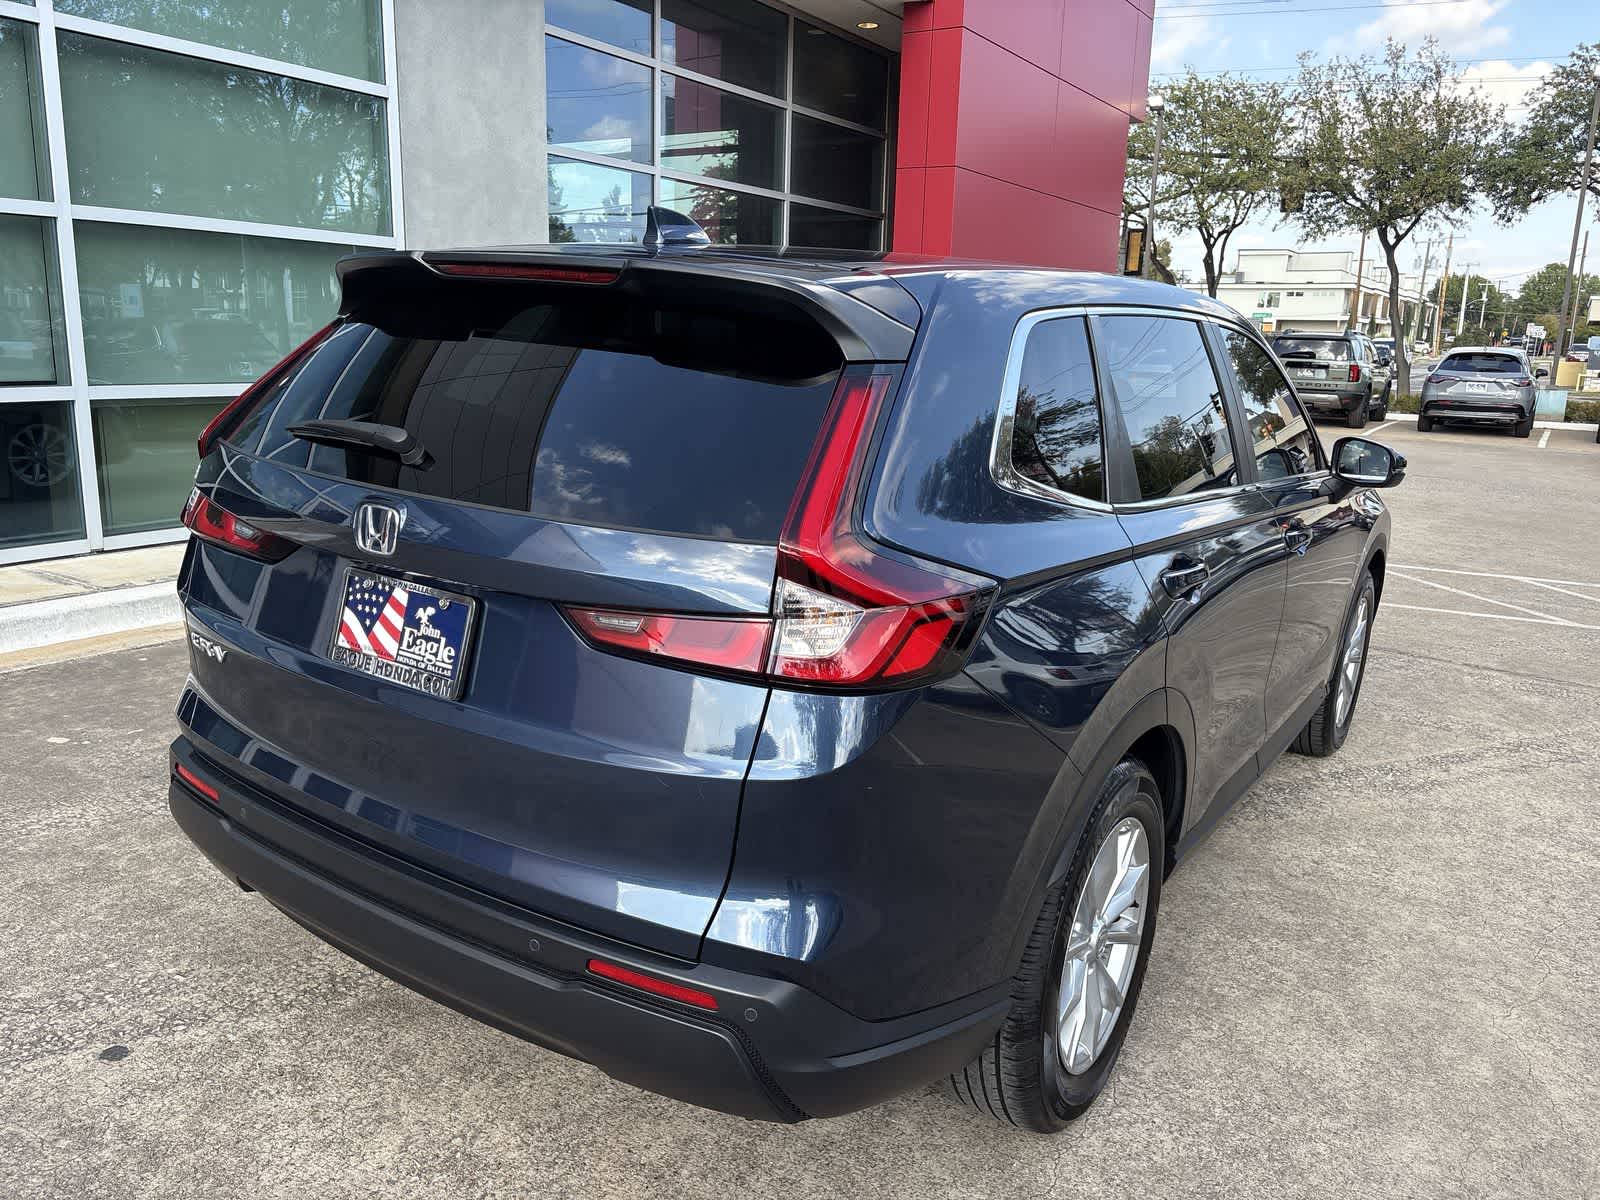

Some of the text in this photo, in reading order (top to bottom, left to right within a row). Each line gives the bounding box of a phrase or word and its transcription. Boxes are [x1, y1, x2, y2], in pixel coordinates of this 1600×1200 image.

[1296, 381, 1342, 389] SPORT
[417, 624, 441, 639] John
[191, 632, 229, 664] CR-V
[400, 626, 456, 665] Eagle
[397, 655, 452, 677] HONDA OF DALLAS
